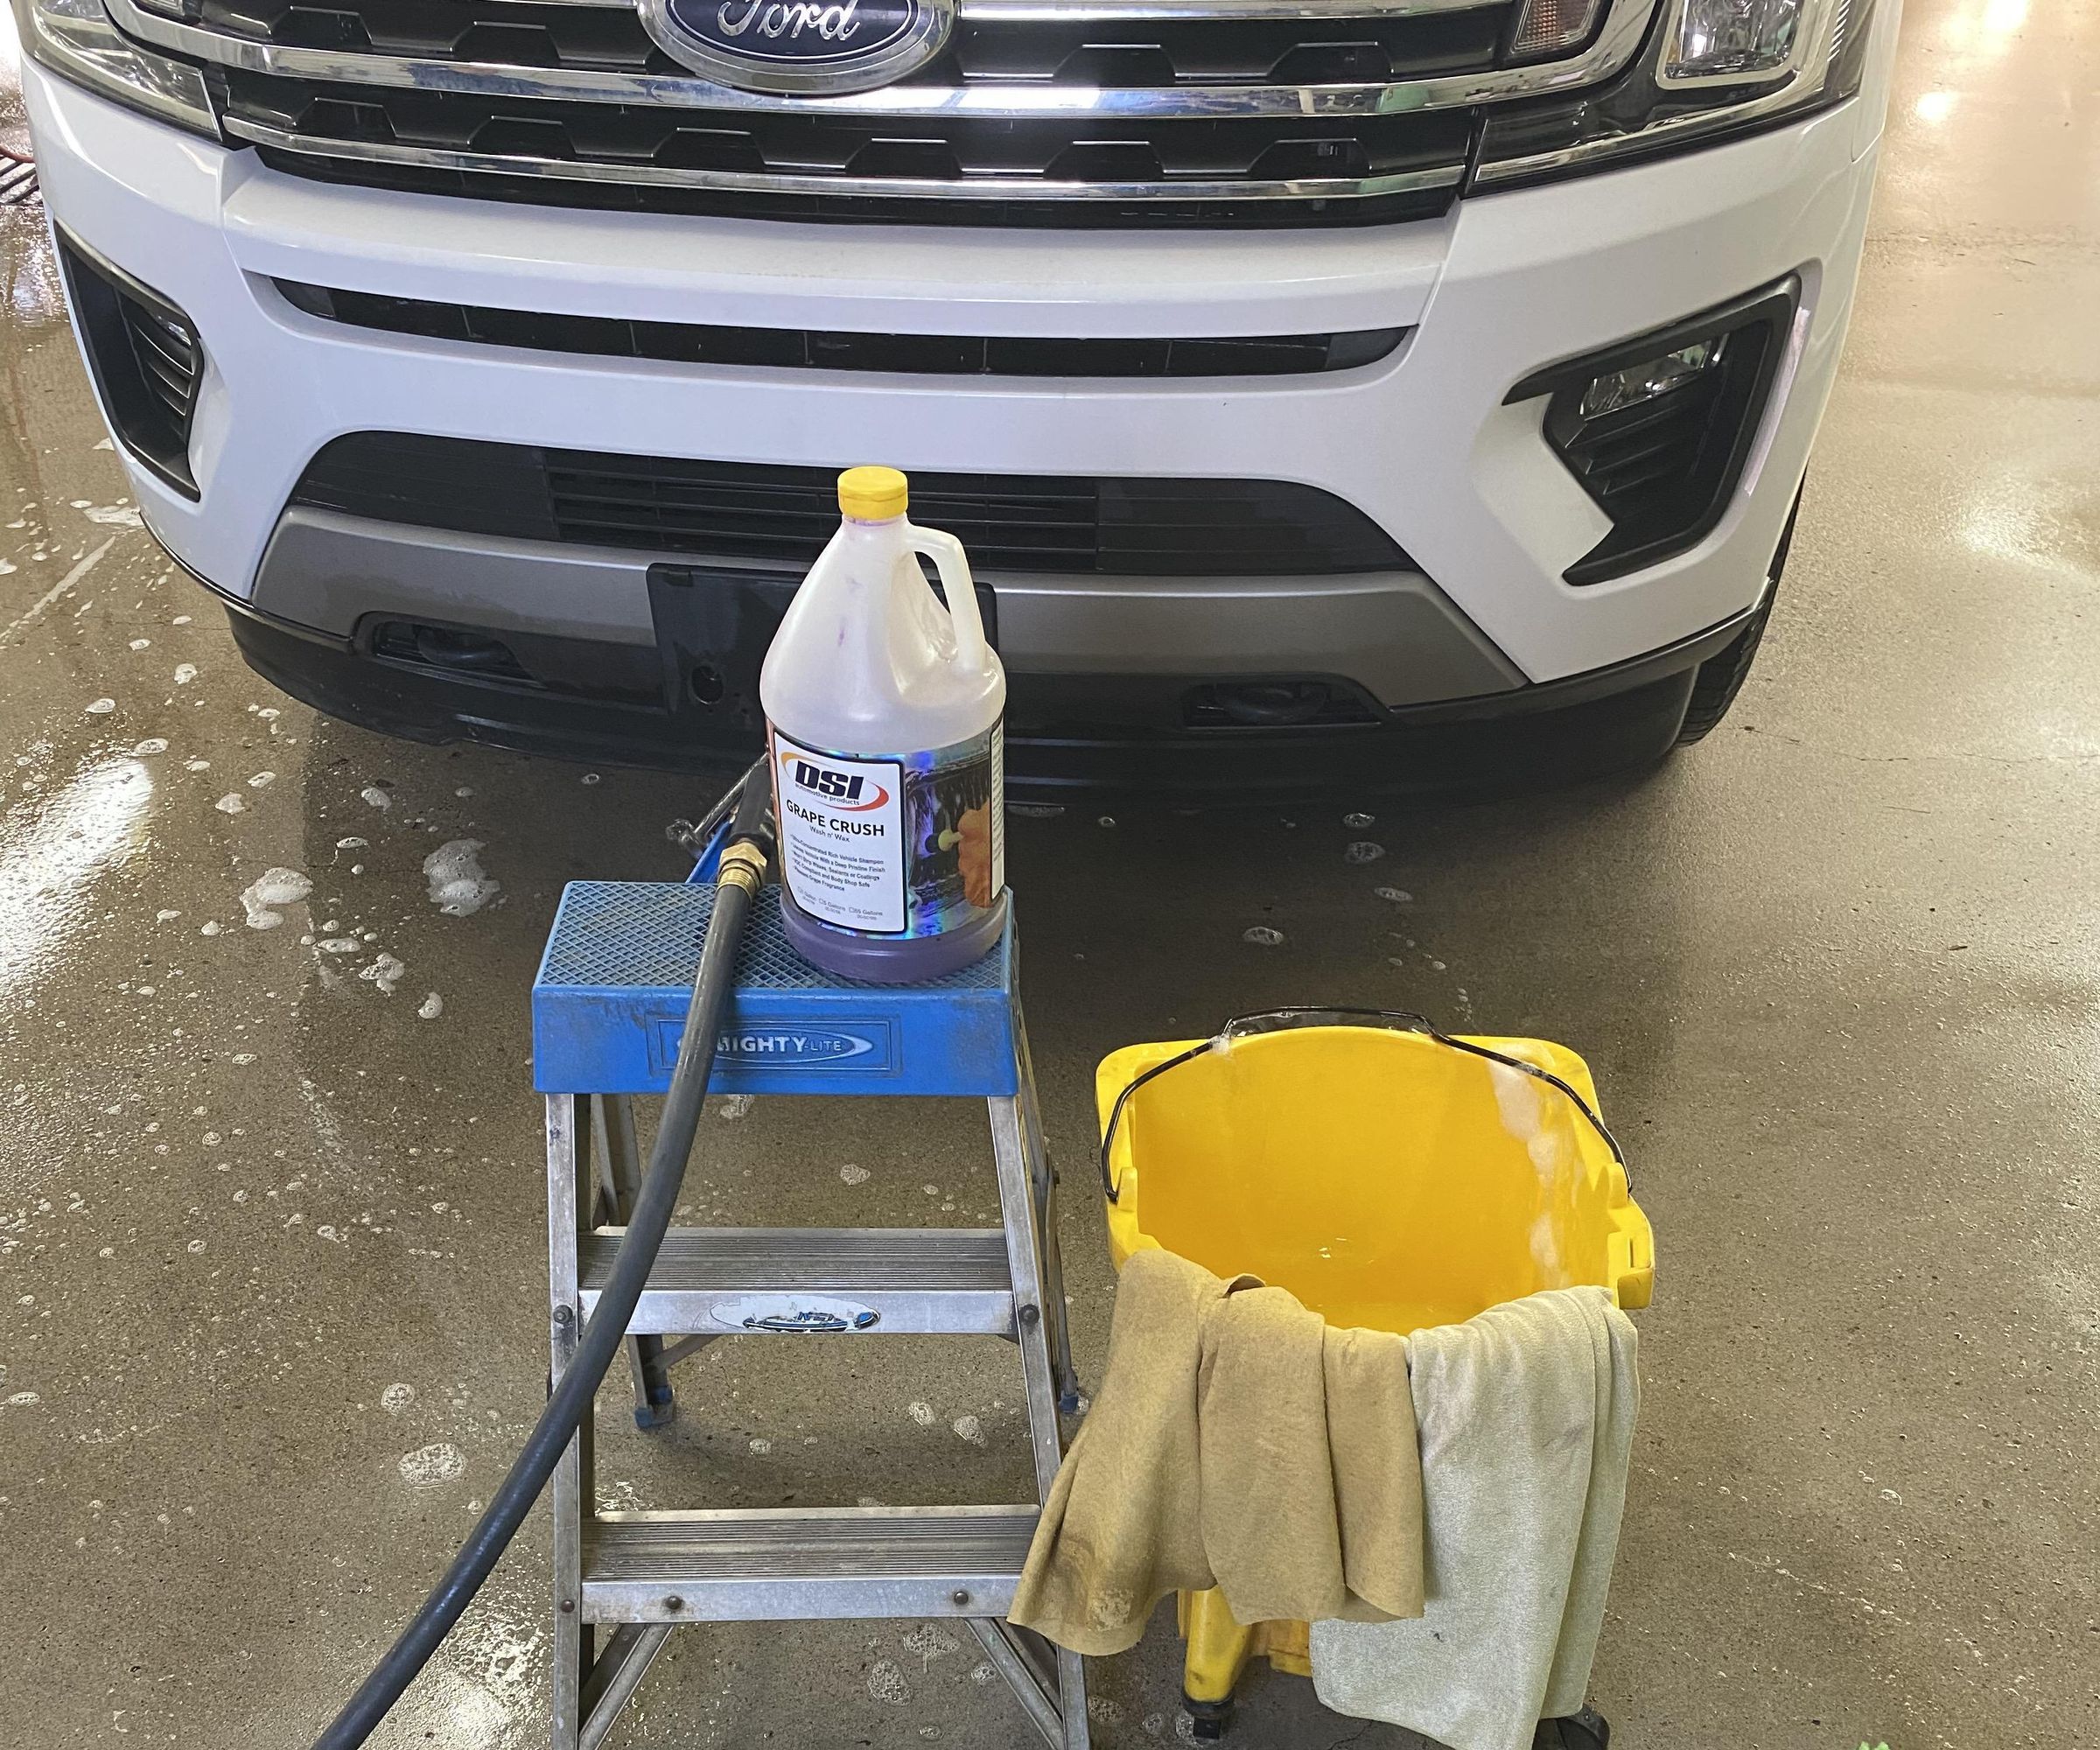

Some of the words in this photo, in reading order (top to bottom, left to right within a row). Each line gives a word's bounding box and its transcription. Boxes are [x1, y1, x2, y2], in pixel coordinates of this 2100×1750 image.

[717, 0, 860, 40] Ford
[794, 782, 828, 800] automotive
[829, 795, 860, 806] products
[795, 760, 864, 800] DSI
[786, 799, 826, 828] GRAPE
[830, 818, 885, 836] CRUSH
[808, 825, 826, 836] Wash
[834, 834, 850, 843] Wax
